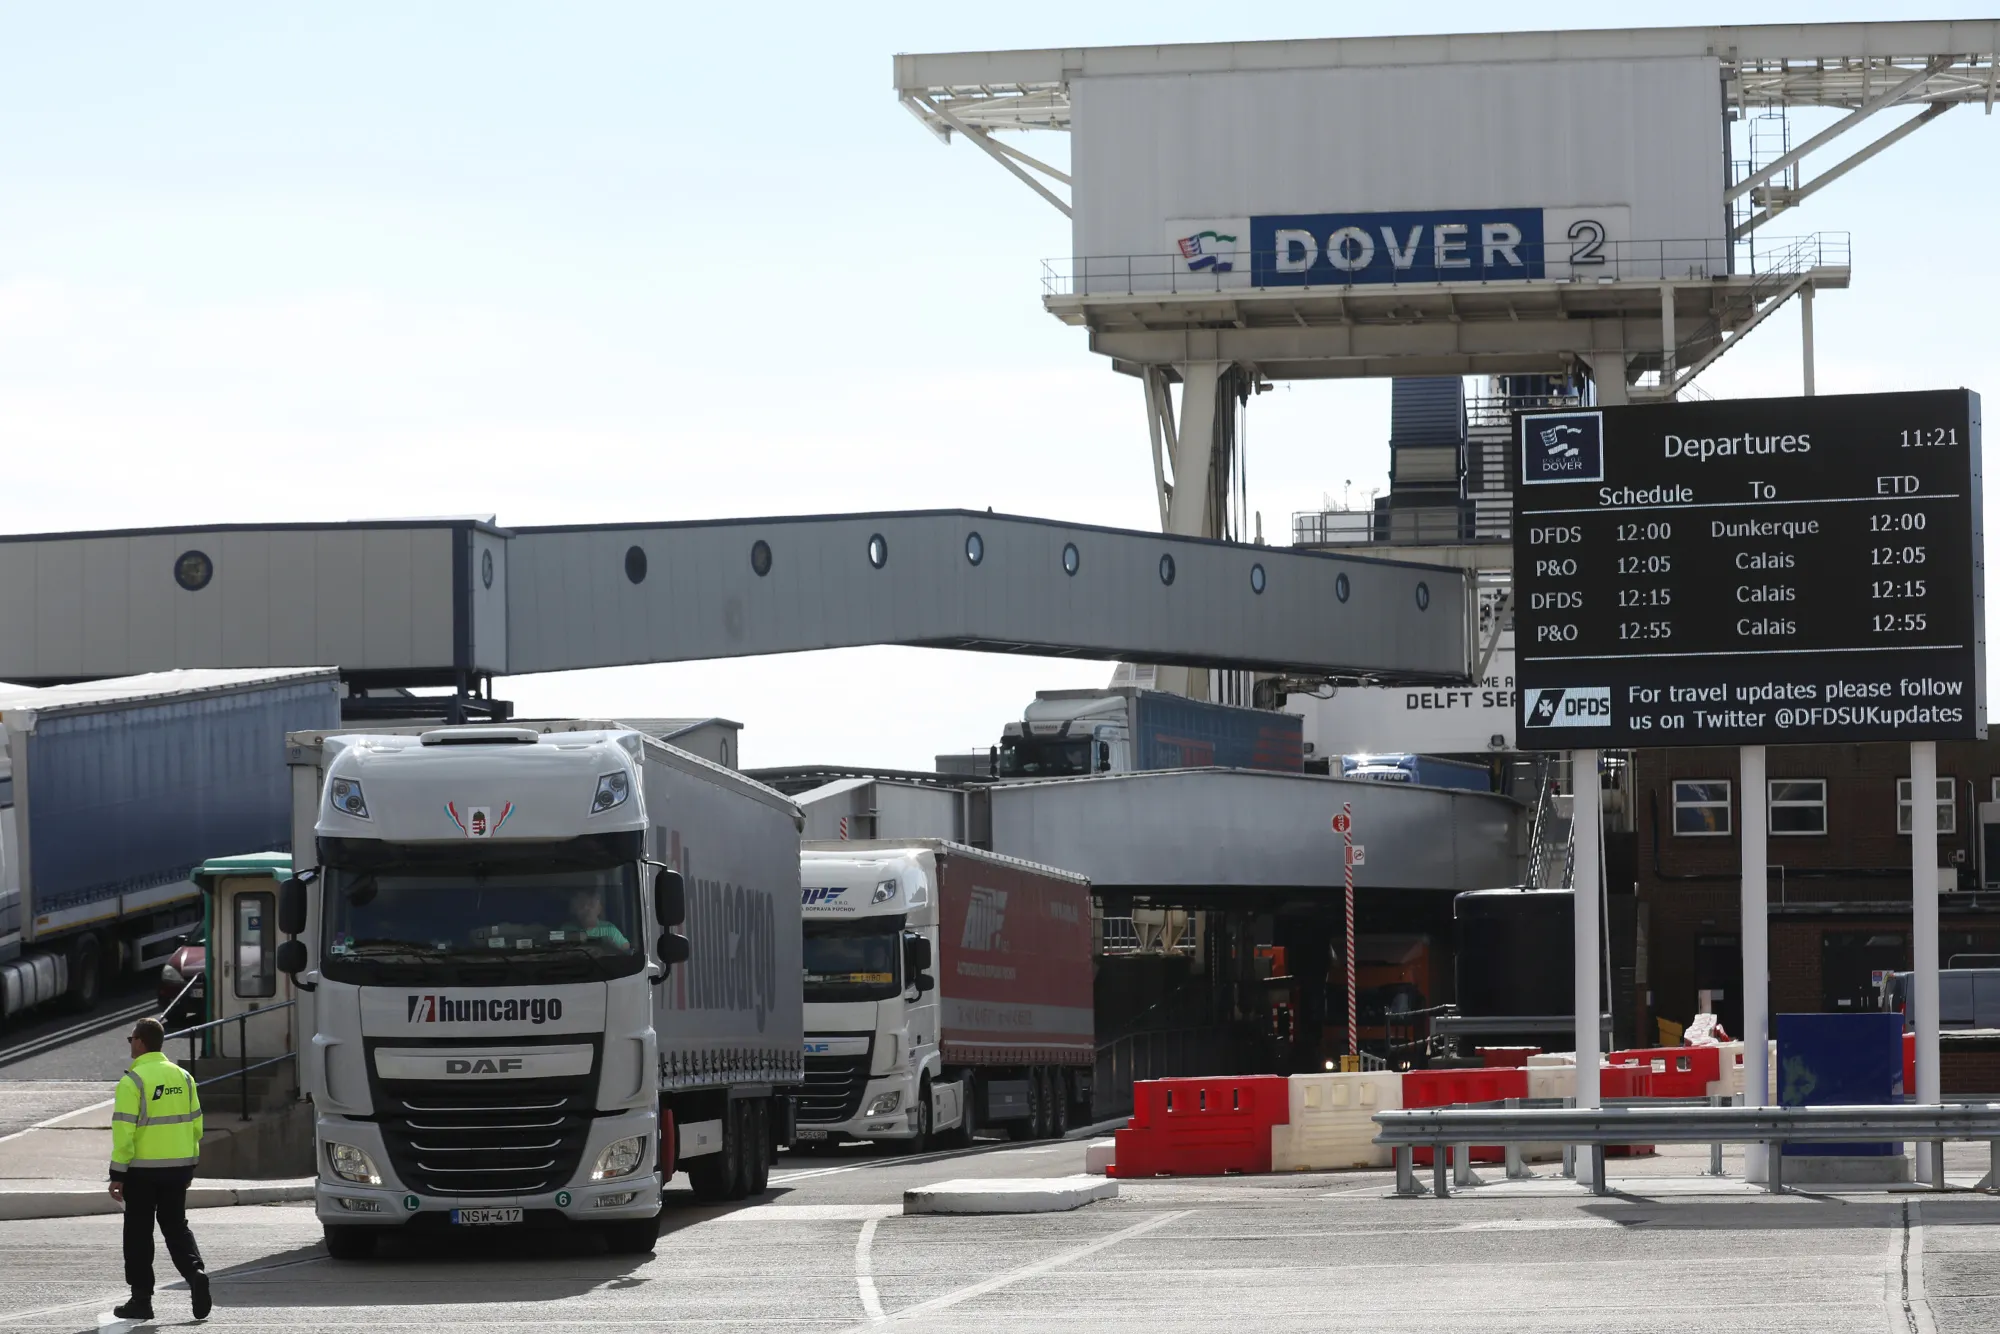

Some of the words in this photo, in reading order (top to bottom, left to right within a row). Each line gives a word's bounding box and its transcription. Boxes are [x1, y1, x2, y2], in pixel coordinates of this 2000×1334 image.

[1274, 221, 1524, 275] DOVER
[1567, 219, 1607, 266] 2
[1665, 432, 1811, 462] Departures
[1901, 428, 1959, 447] 11:21
[1542, 462, 1582, 471] DOVER
[1599, 484, 1694, 506] Schedule
[1749, 482, 1777, 500] To
[1876, 476, 1920, 494] ETD
[1530, 526, 1582, 544] DFDS
[1616, 523, 1671, 541] 12:00
[1711, 519, 1820, 539] Dunkerque
[1870, 513, 1926, 532] 12:00
[1536, 559, 1578, 577] P&O
[1617, 556, 1671, 574] 12:05
[1735, 551, 1795, 570] Calais
[1871, 547, 1926, 565] 12:05
[1531, 592, 1583, 609] DFDS
[1618, 588, 1671, 606] 12:15
[1736, 584, 1796, 603] Calais
[1872, 580, 1927, 598] 12:15
[1537, 625, 1579, 642] P&O
[1619, 621, 1672, 640] 12:55
[1737, 617, 1797, 636] Calais
[1873, 613, 1927, 632] 12:55
[1406, 692, 1473, 709] DELFT
[1629, 686, 1661, 703] For
[1670, 683, 1727, 702] travel
[1736, 682, 1817, 705] updates
[1825, 681, 1892, 703] please
[1900, 678, 1963, 696] follow
[1564, 697, 1610, 717] DFDS
[1629, 715, 1652, 730] us
[1660, 714, 1685, 729] on
[1693, 710, 1766, 728] Twitter
[1775, 705, 1963, 729] @DFDSUKupdates
[1377, 771, 1407, 781] river
[1337, 815, 1345, 831] STOP
[683, 846, 777, 1034] huncargo
[439, 995, 563, 1024] huncargo
[803, 1044, 829, 1053] AF
[446, 1058, 523, 1074] DAF
[164, 1086, 183, 1095] DFDS
[558, 1193, 568, 1206] 6
[460, 1209, 520, 1223] NSW-417
